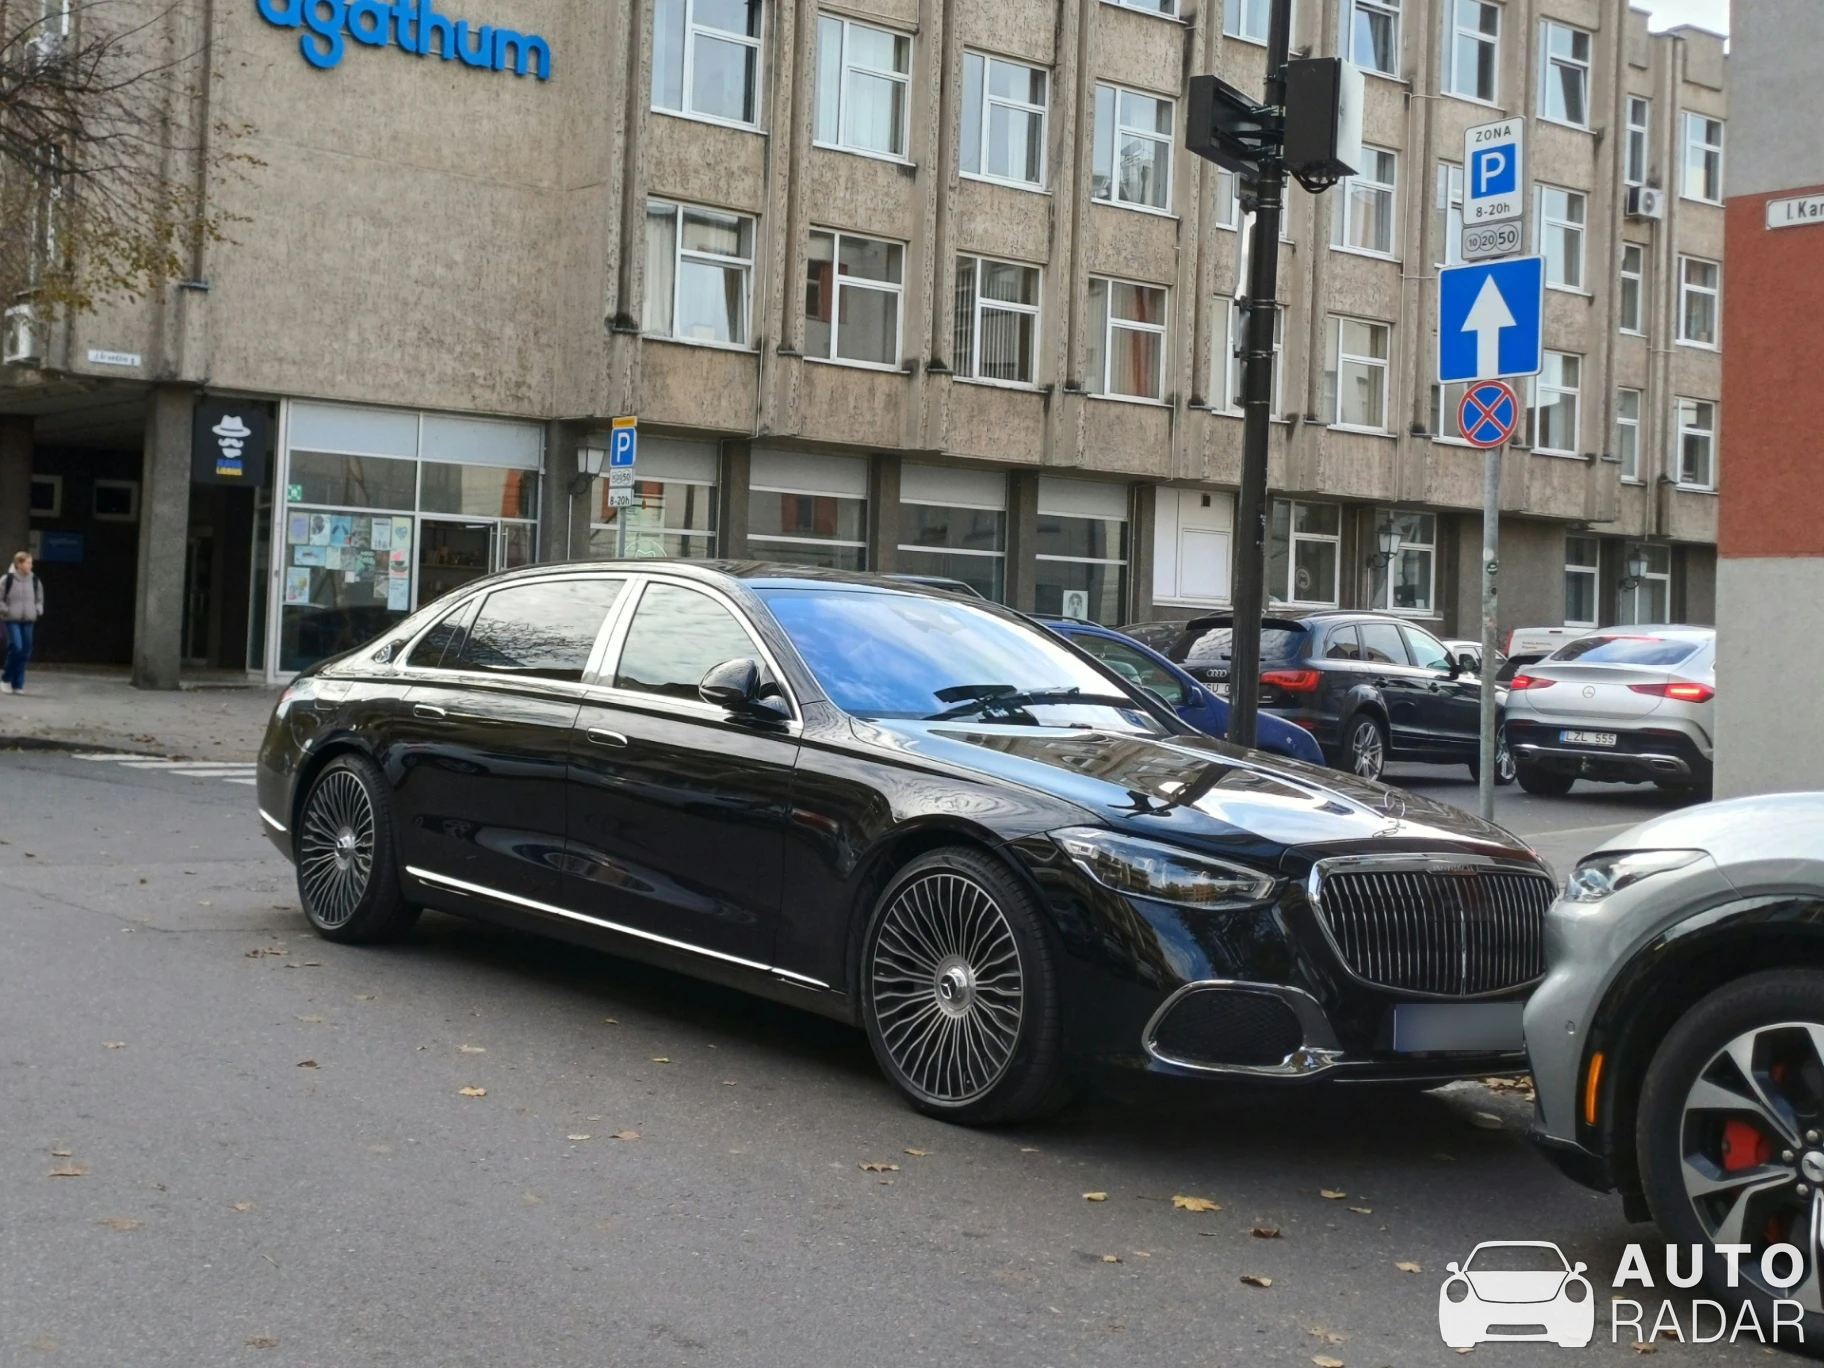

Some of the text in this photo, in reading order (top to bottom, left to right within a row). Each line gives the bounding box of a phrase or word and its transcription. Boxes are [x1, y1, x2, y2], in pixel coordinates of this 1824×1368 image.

[256, 0, 550, 80] agathum
[1475, 125, 1511, 143] ZONA
[1480, 152, 1506, 193] P
[1476, 202, 1510, 218] 8-20h
[1469, 230, 1516, 248] 10 20 50
[616, 431, 631, 463] P
[622, 472, 631, 482] 50
[609, 495, 630, 506] 8-20h
[1566, 731, 1614, 744] LZL 555
